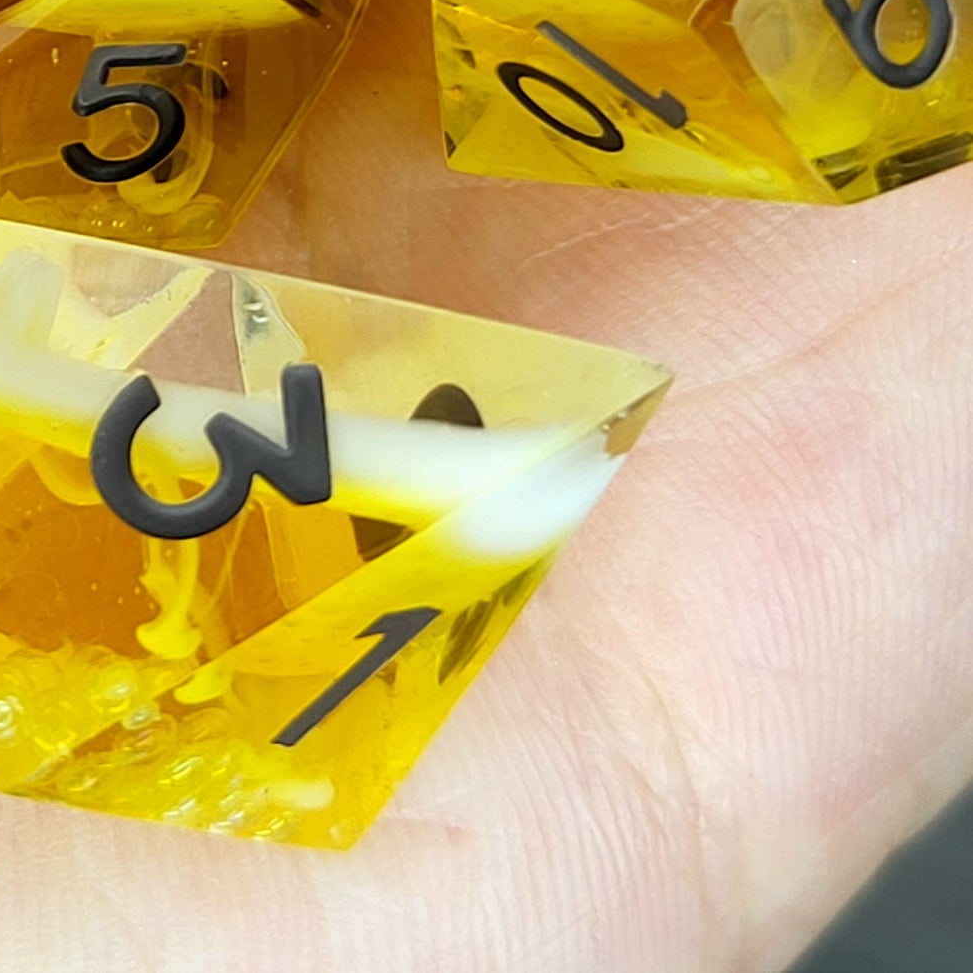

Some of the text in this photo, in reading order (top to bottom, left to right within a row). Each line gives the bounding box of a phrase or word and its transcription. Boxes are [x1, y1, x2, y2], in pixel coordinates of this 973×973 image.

[60, 42, 187, 185] 5
[89, 362, 333, 541] 3
[270, 605, 443, 748] 1
